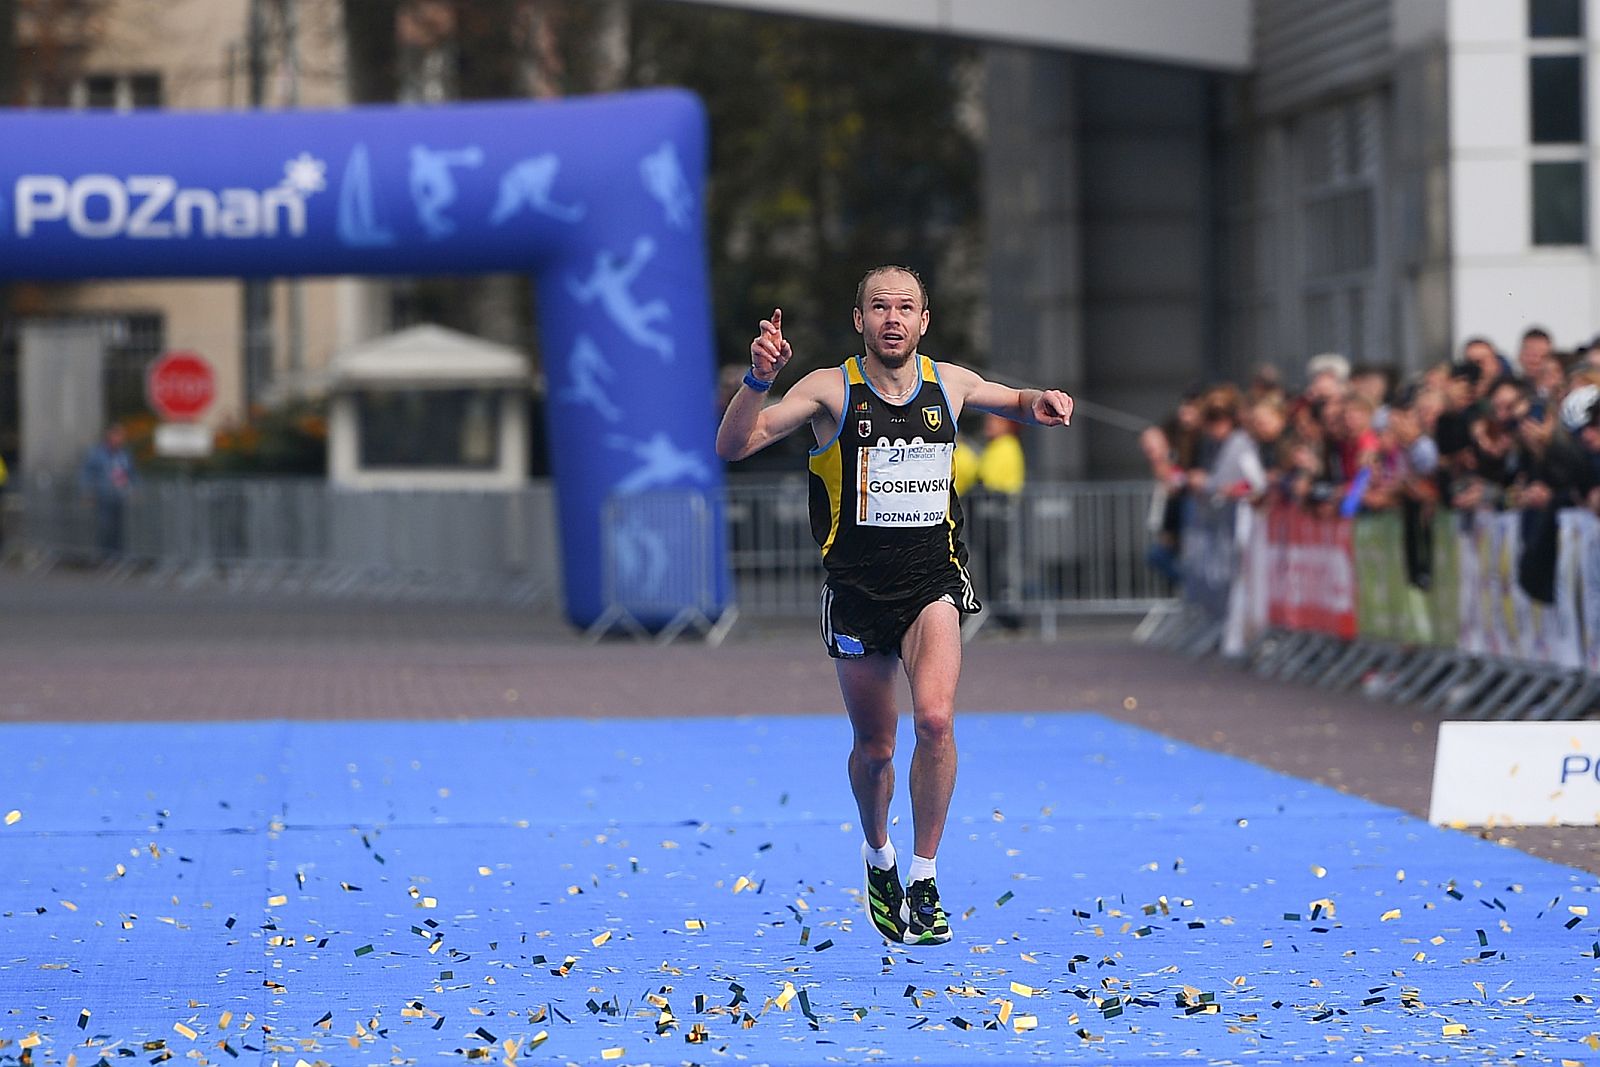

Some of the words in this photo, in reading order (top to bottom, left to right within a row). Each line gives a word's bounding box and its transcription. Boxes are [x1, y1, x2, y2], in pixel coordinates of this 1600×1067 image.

[888, 448, 905, 462] 21
[869, 479, 948, 493] GOSIEWSKI
[875, 510, 921, 522] POZNAŃ
[1561, 755, 1600, 784] P
